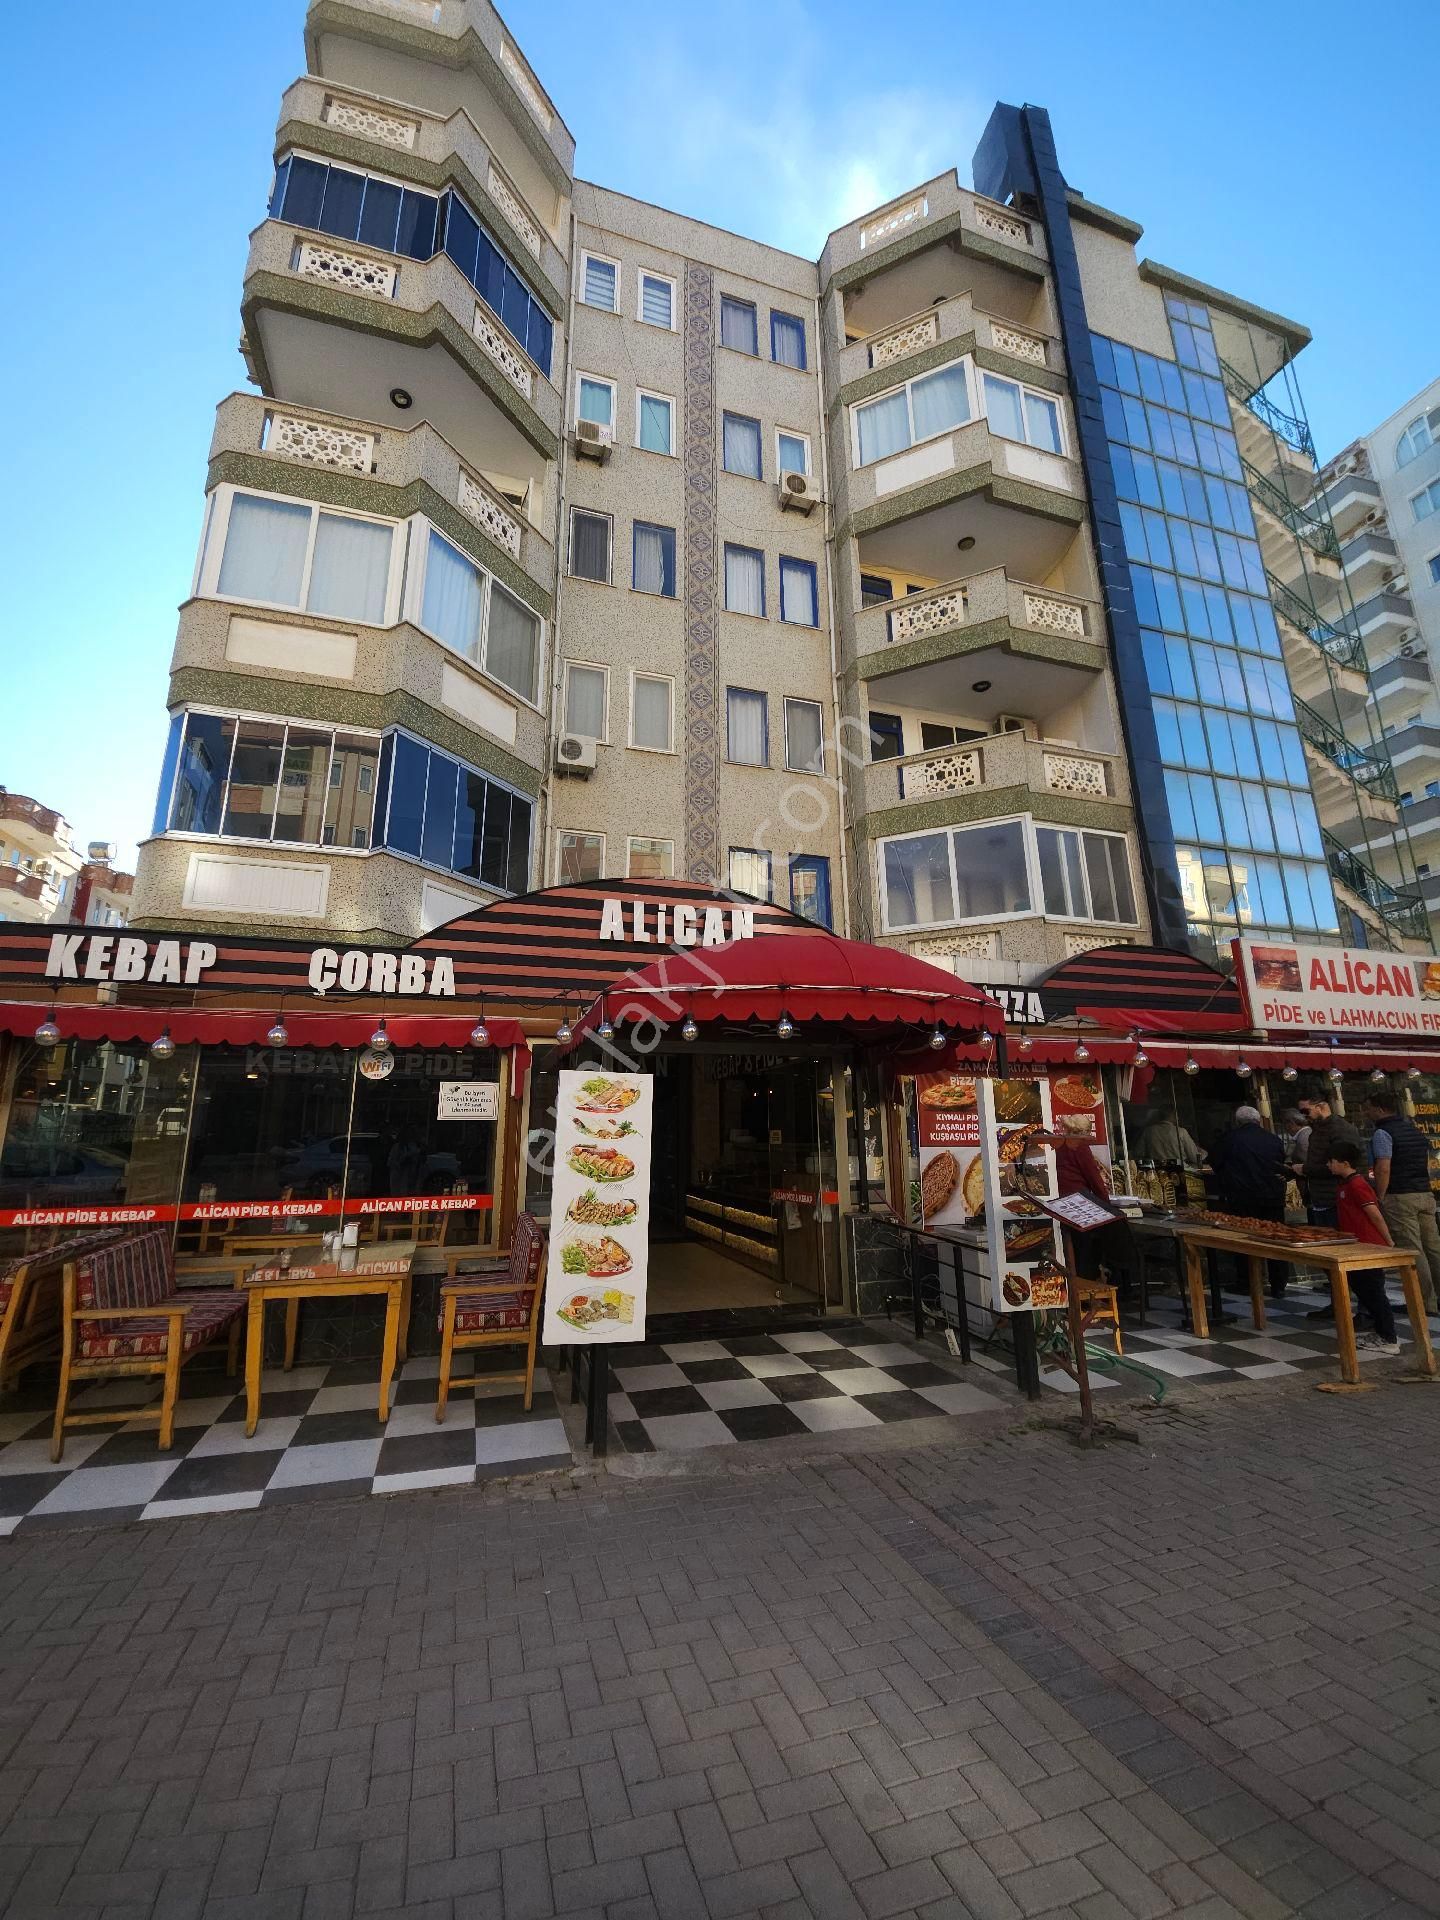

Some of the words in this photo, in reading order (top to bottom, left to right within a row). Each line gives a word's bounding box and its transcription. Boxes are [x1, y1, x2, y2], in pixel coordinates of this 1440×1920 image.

[45, 933, 217, 984] KEBAP
[308, 948, 456, 996] ÇORBA
[1310, 952, 1414, 998] ALİCAN
[1263, 998, 1304, 1024] PİDE
[1307, 1010, 1326, 1025] ve
[1329, 1007, 1418, 1031] LAHMACUN
[935, 1113, 965, 1121] KIYMALI
[966, 1112, 979, 1121] PİD
[966, 1121, 979, 1131] PİD
[192, 1204, 241, 1218] ALİCAN
[241, 1203, 270, 1216] PİDE
[272, 1206, 280, 1216] &
[282, 1203, 323, 1215] KEBAP
[360, 1199, 403, 1213] ALİCAN
[404, 1198, 430, 1211] PİDE
[431, 1200, 439, 1210] &
[440, 1198, 477, 1210] KEBAP
[12, 1211, 65, 1225] ALİCAN
[65, 1209, 97, 1223] PİDE
[98, 1212, 109, 1222] &
[111, 1209, 156, 1222] KEBAP
